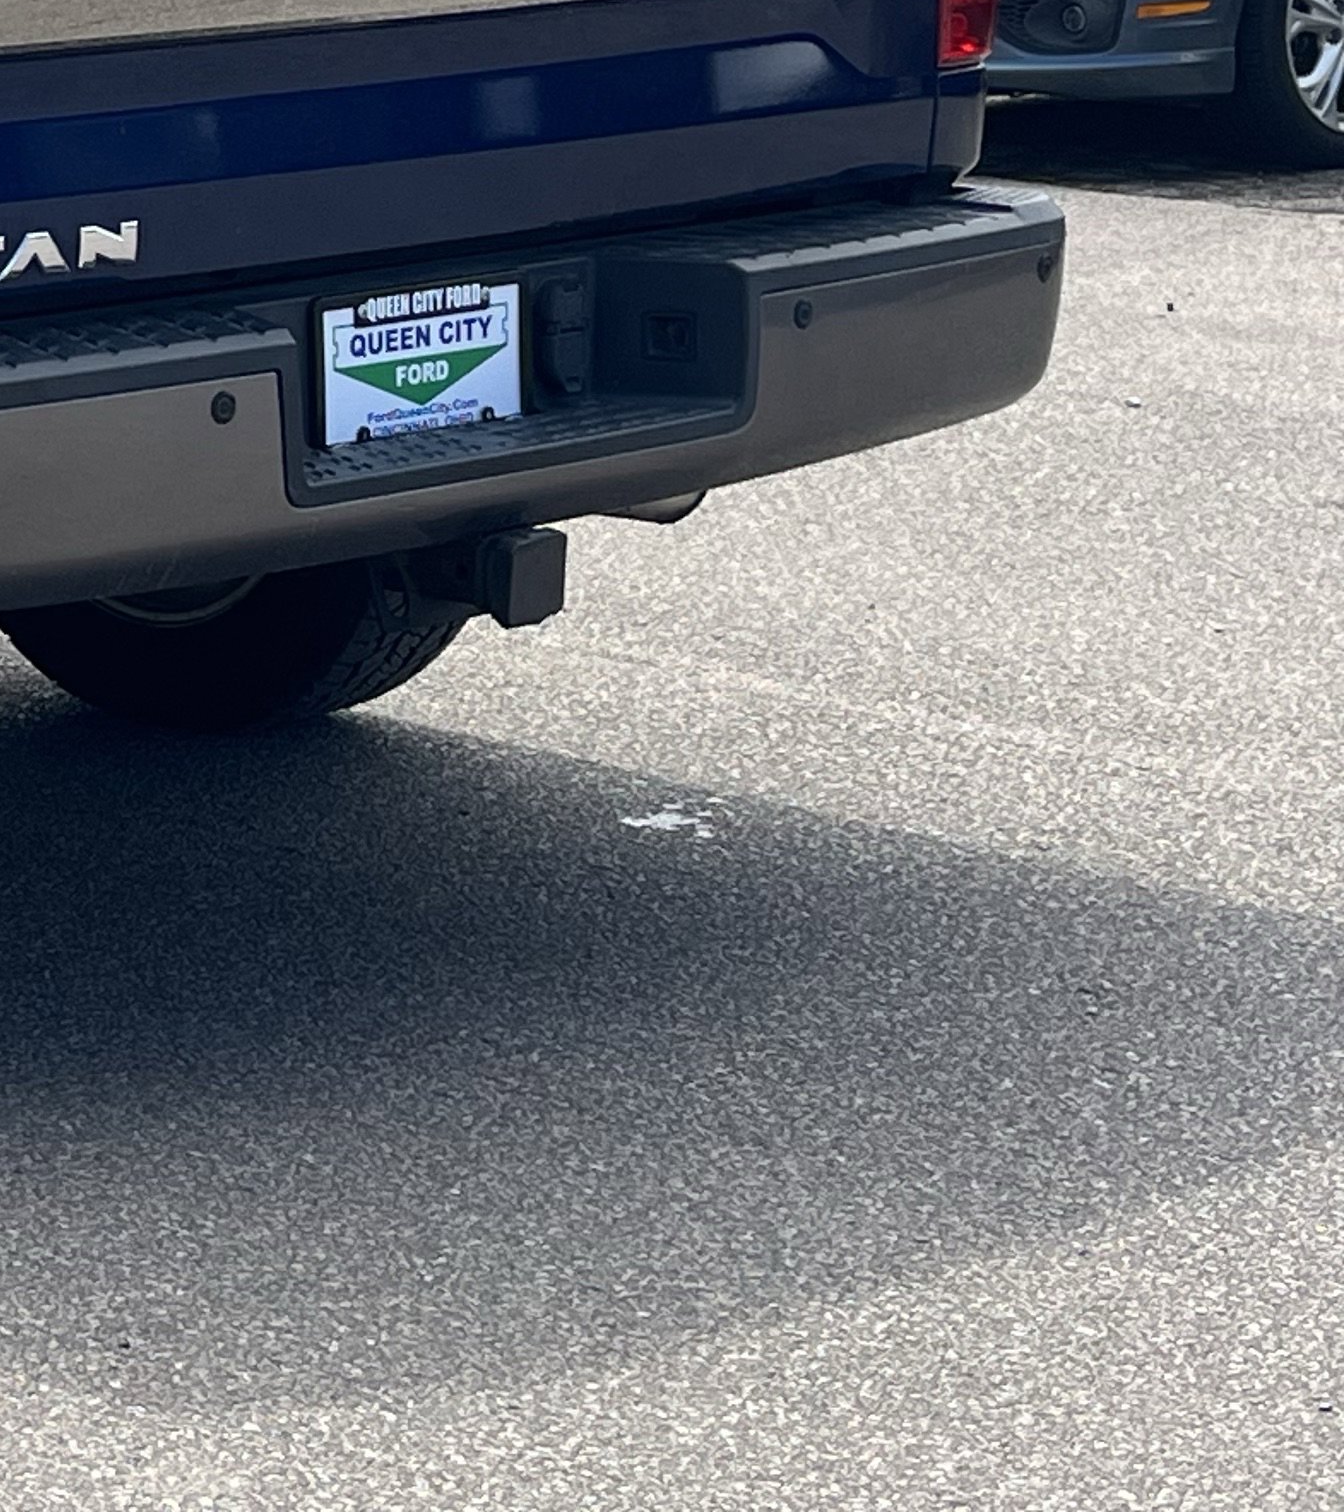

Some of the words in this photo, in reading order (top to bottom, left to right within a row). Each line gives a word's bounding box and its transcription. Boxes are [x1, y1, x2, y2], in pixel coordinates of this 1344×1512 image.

[367, 294, 410, 321] QUEEN
[413, 287, 444, 314] CITY
[446, 284, 481, 309] FORD
[349, 323, 431, 358] QUEEN
[438, 316, 493, 344] CITY
[395, 360, 450, 387] FORD
